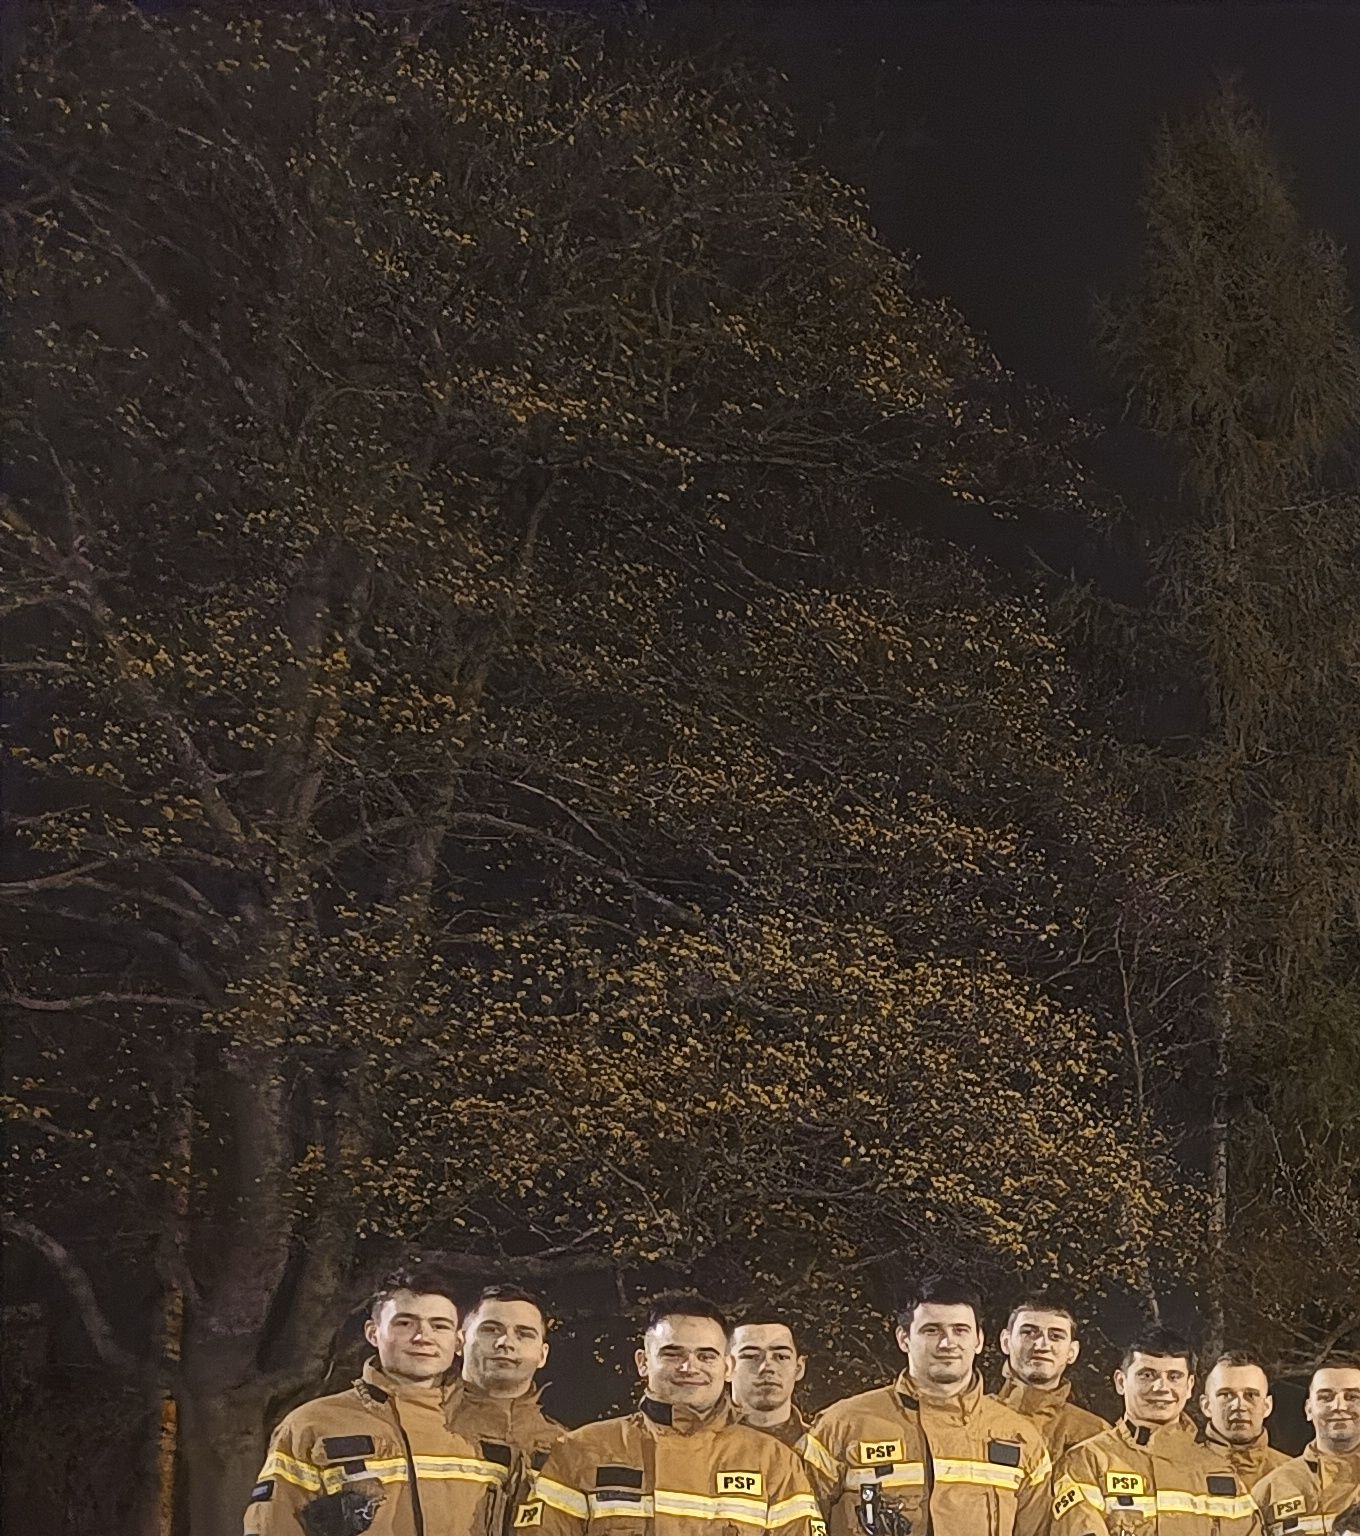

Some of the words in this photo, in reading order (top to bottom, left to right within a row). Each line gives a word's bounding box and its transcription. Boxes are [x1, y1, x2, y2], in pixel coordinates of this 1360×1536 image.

[866, 1444, 896, 1460] PSP
[724, 1476, 755, 1490] PSP
[1112, 1476, 1138, 1489] PSP
[1054, 1489, 1075, 1514] PSP
[1277, 1499, 1301, 1515] PSP
